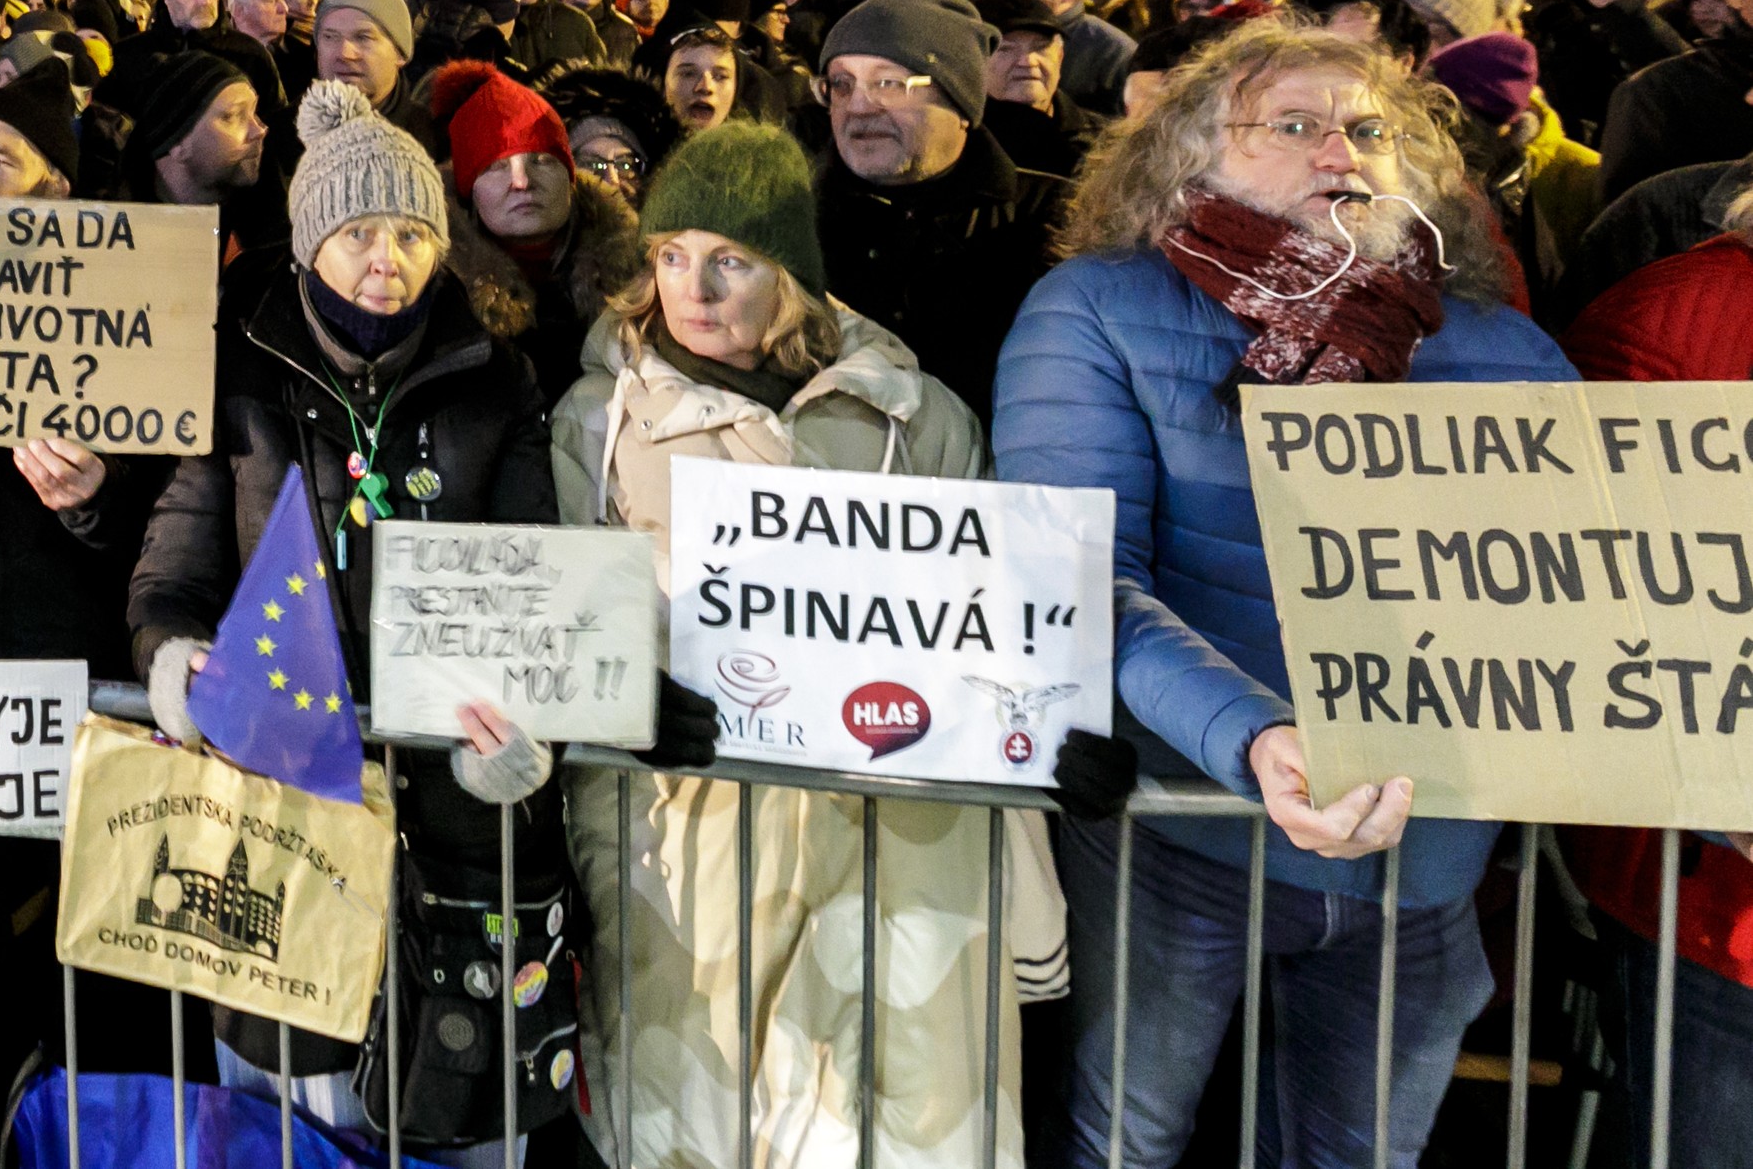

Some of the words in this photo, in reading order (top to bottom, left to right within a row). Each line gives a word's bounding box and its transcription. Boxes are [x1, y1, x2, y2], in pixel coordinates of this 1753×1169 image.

[7, 207, 64, 248] SA
[76, 210, 136, 250] DA
[42, 402, 164, 445] 4000
[1261, 411, 1575, 479] PODLIAK
[1598, 416, 1753, 474] FIC
[698, 562, 995, 653] ŠPINAVÁ
[502, 661, 578, 704] MOC
[1309, 630, 1576, 732] PRÁVNY
[719, 712, 807, 748] MER
[852, 700, 920, 727] HLAS
[164, 941, 244, 979] DOMOV
